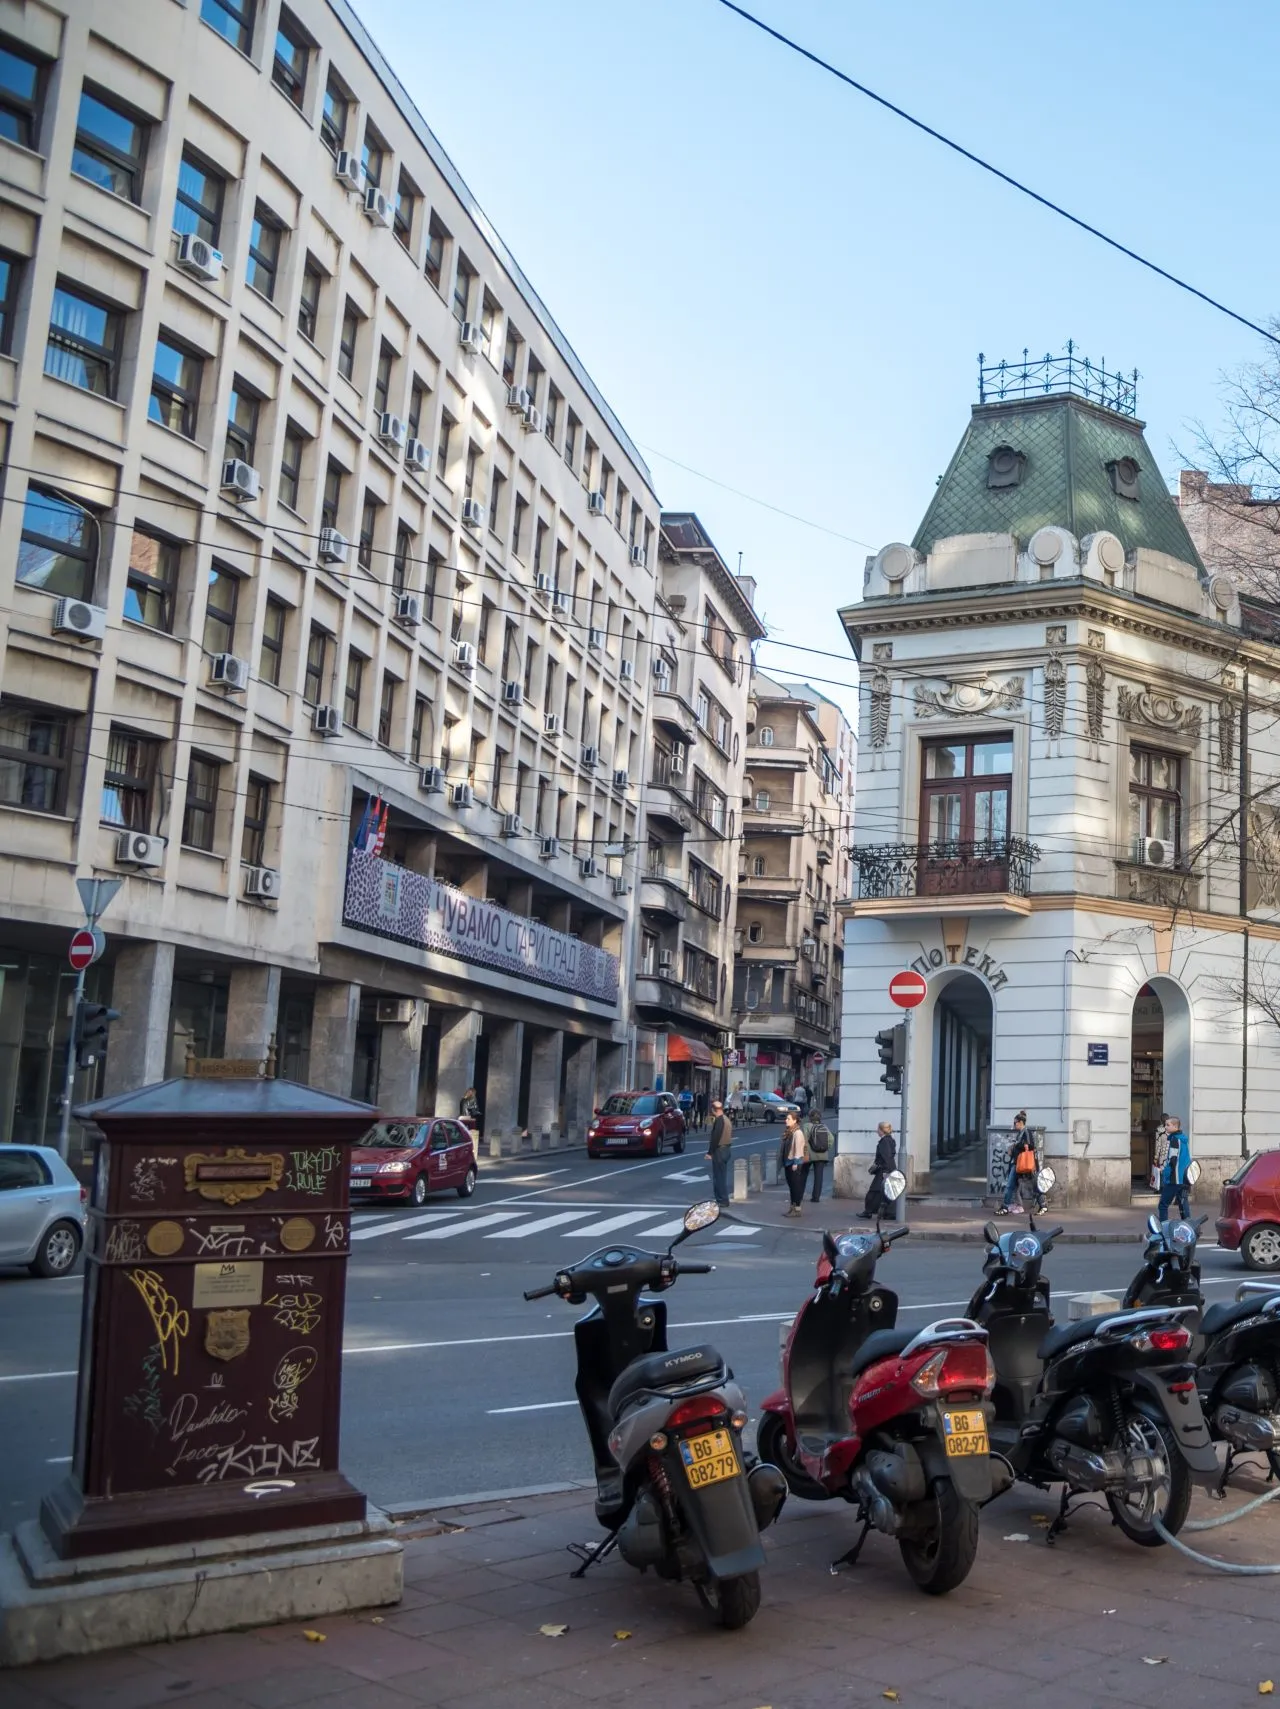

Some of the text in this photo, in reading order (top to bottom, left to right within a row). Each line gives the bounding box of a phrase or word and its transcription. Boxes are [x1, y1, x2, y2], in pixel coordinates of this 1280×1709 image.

[435, 891, 577, 976] ЧУВАМО СТАРИ ГРАД
[911, 944, 1008, 991] ПОТЕКА
[664, 1352, 703, 1367] KYMCO
[954, 1415, 969, 1431] BG
[693, 1439, 712, 1459] BG
